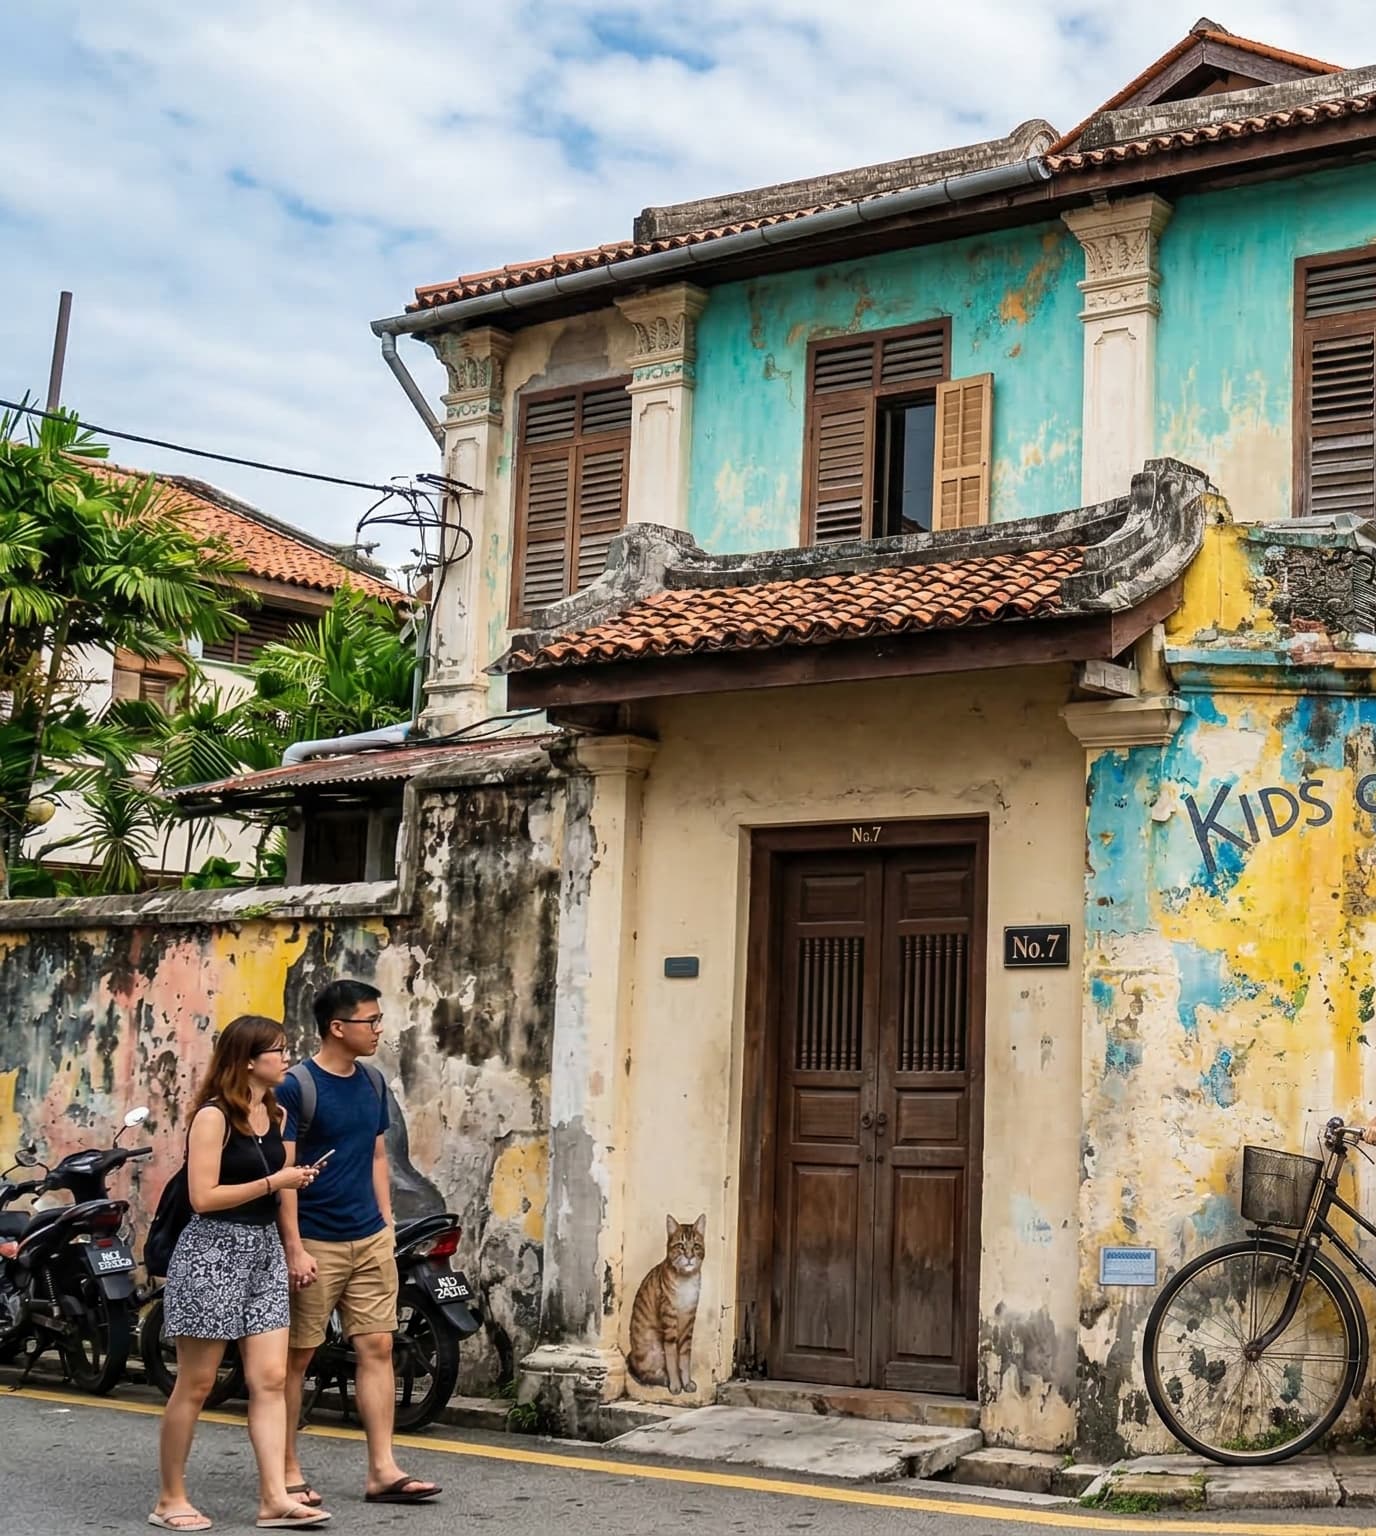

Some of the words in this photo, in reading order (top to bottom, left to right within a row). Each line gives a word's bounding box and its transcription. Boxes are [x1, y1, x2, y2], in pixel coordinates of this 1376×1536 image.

[852, 826, 882, 842] No.7
[1184, 778, 1333, 874] KIDS
[1011, 934, 1061, 959] No.7
